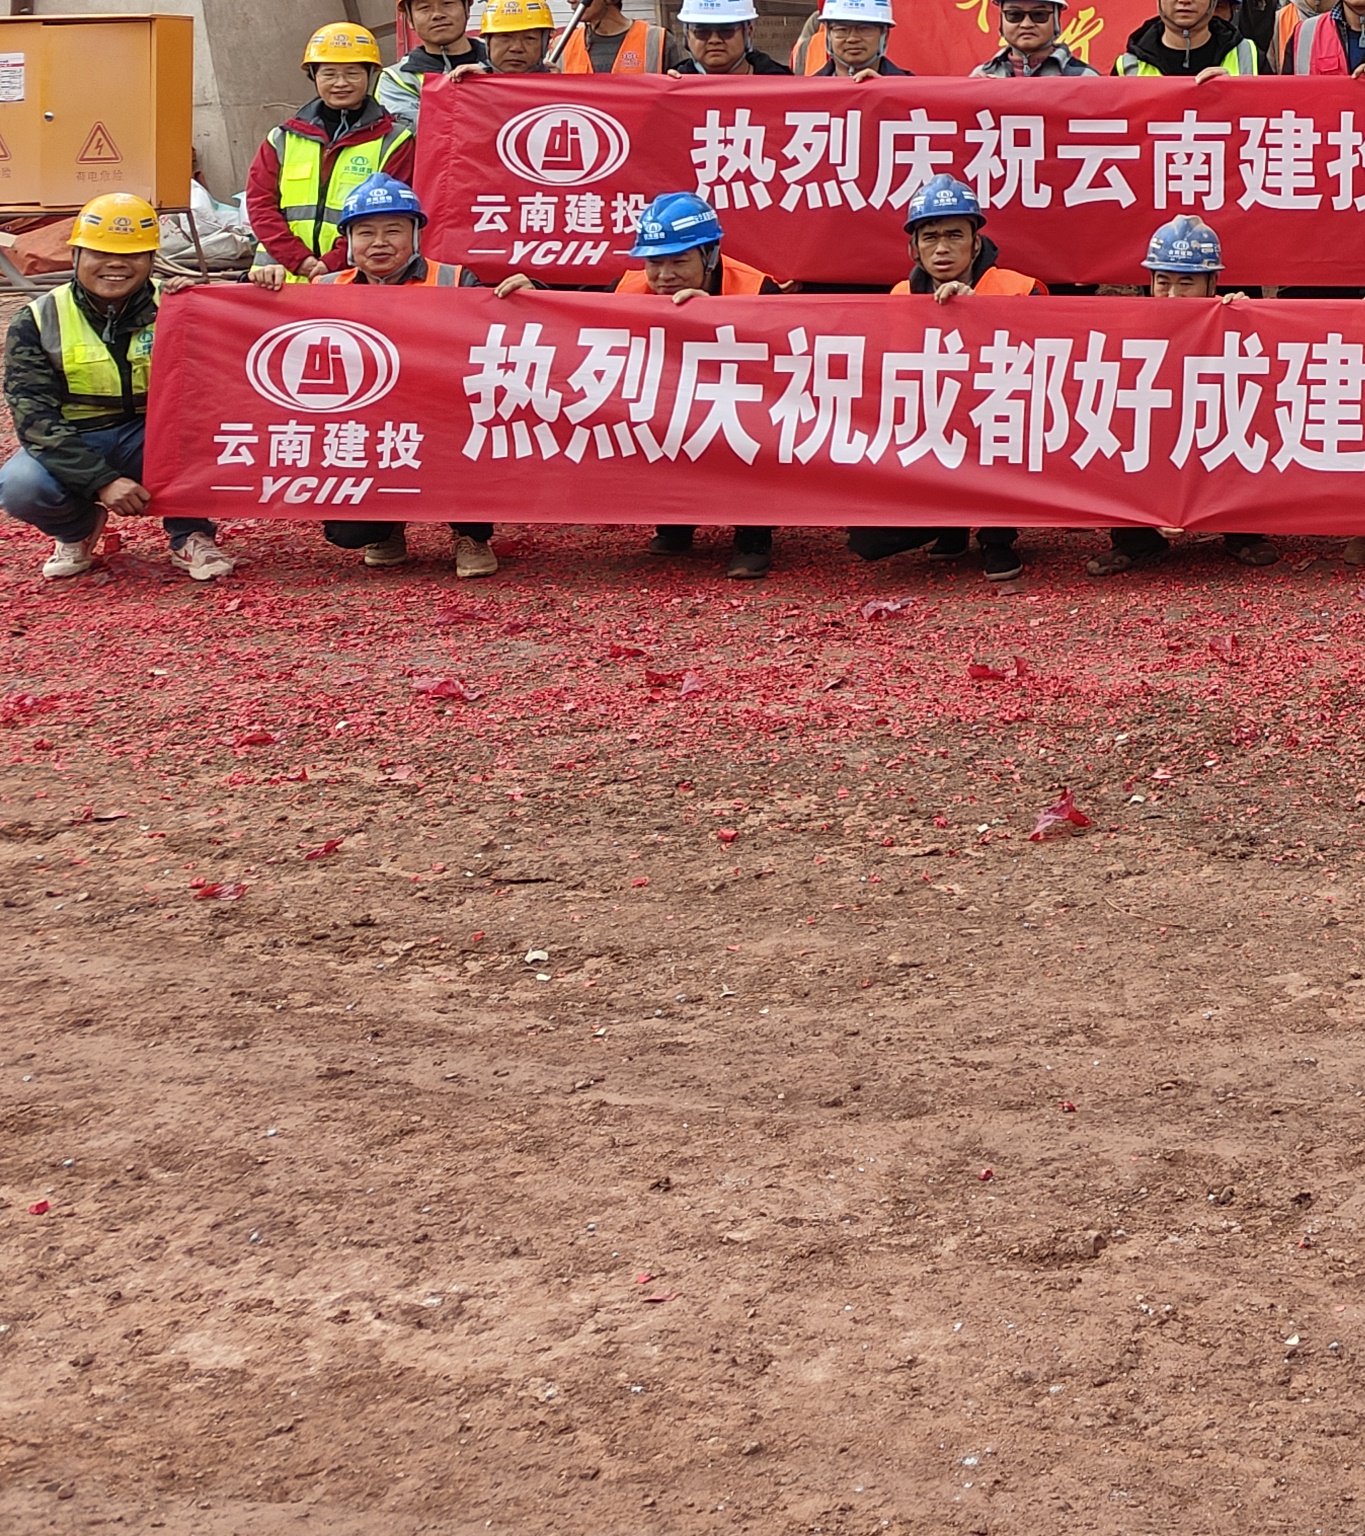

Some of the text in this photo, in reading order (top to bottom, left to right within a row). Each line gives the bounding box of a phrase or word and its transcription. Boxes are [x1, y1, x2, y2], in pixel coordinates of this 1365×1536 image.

[469, 191, 650, 235] 云南建投
[508, 240, 609, 265] YCIH
[213, 419, 425, 469] 云南建投
[257, 476, 375, 506] YCIH
